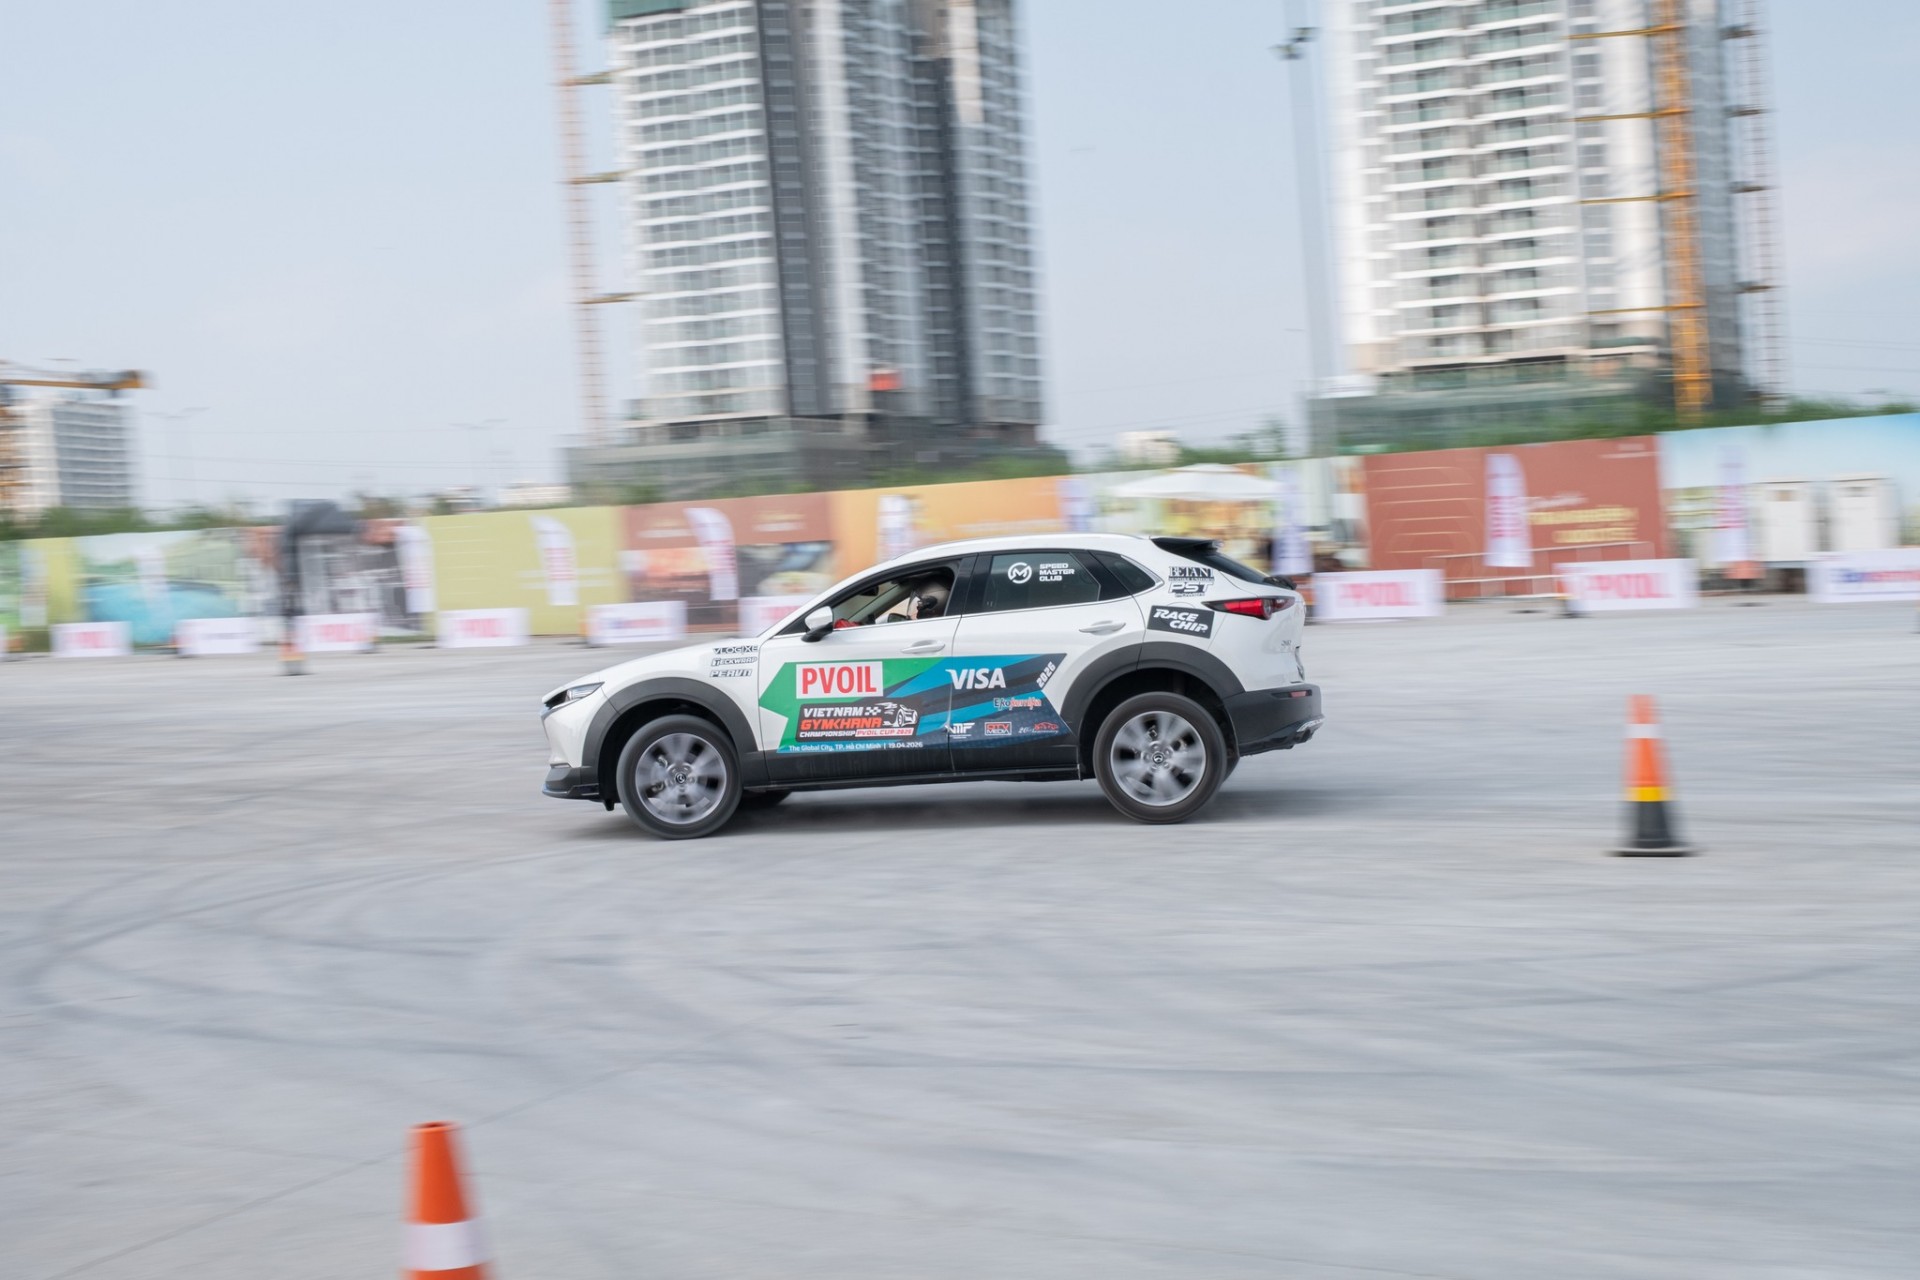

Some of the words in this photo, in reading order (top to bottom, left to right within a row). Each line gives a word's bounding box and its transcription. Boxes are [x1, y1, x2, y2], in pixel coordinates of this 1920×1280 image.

[1169, 581, 1214, 593] PST
[1153, 608, 1199, 622] RACE
[1169, 620, 1208, 633] CHIP
[802, 665, 877, 694] PVOIL
[945, 668, 1006, 689] VISA
[1036, 661, 1057, 688] 2026
[803, 707, 863, 717] VIETNAM
[800, 717, 882, 730] GYMKHANA
[821, 743, 834, 751] City,
[888, 741, 923, 749] 19.04.2026
